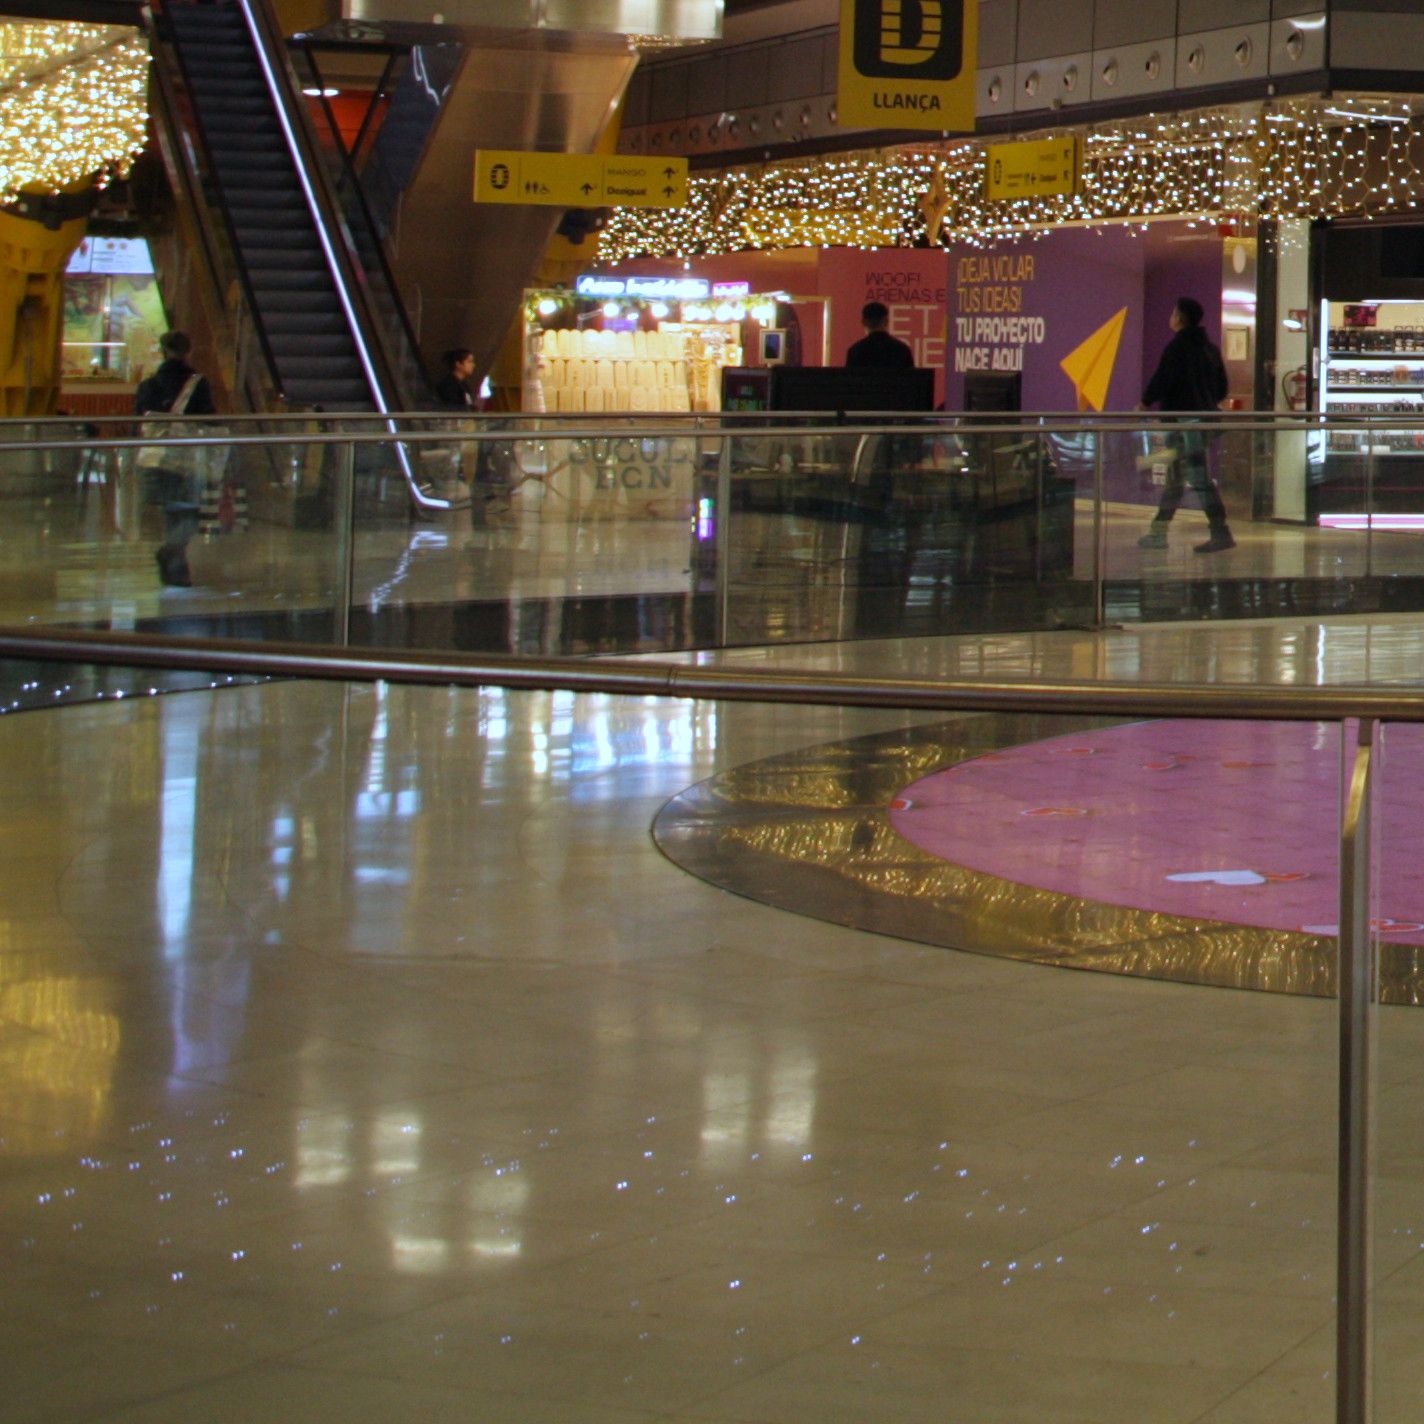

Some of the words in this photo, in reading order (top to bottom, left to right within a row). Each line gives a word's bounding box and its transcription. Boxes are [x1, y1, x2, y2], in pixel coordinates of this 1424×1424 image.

[873, 93, 940, 113] LLANÇA
[865, 288, 931, 303] ARENAS
[957, 288, 981, 312] TUS
[889, 304, 938, 335] ET
[956, 318, 972, 343] TU
[975, 317, 1044, 344] PROYECTO
[955, 347, 989, 372] NACE
